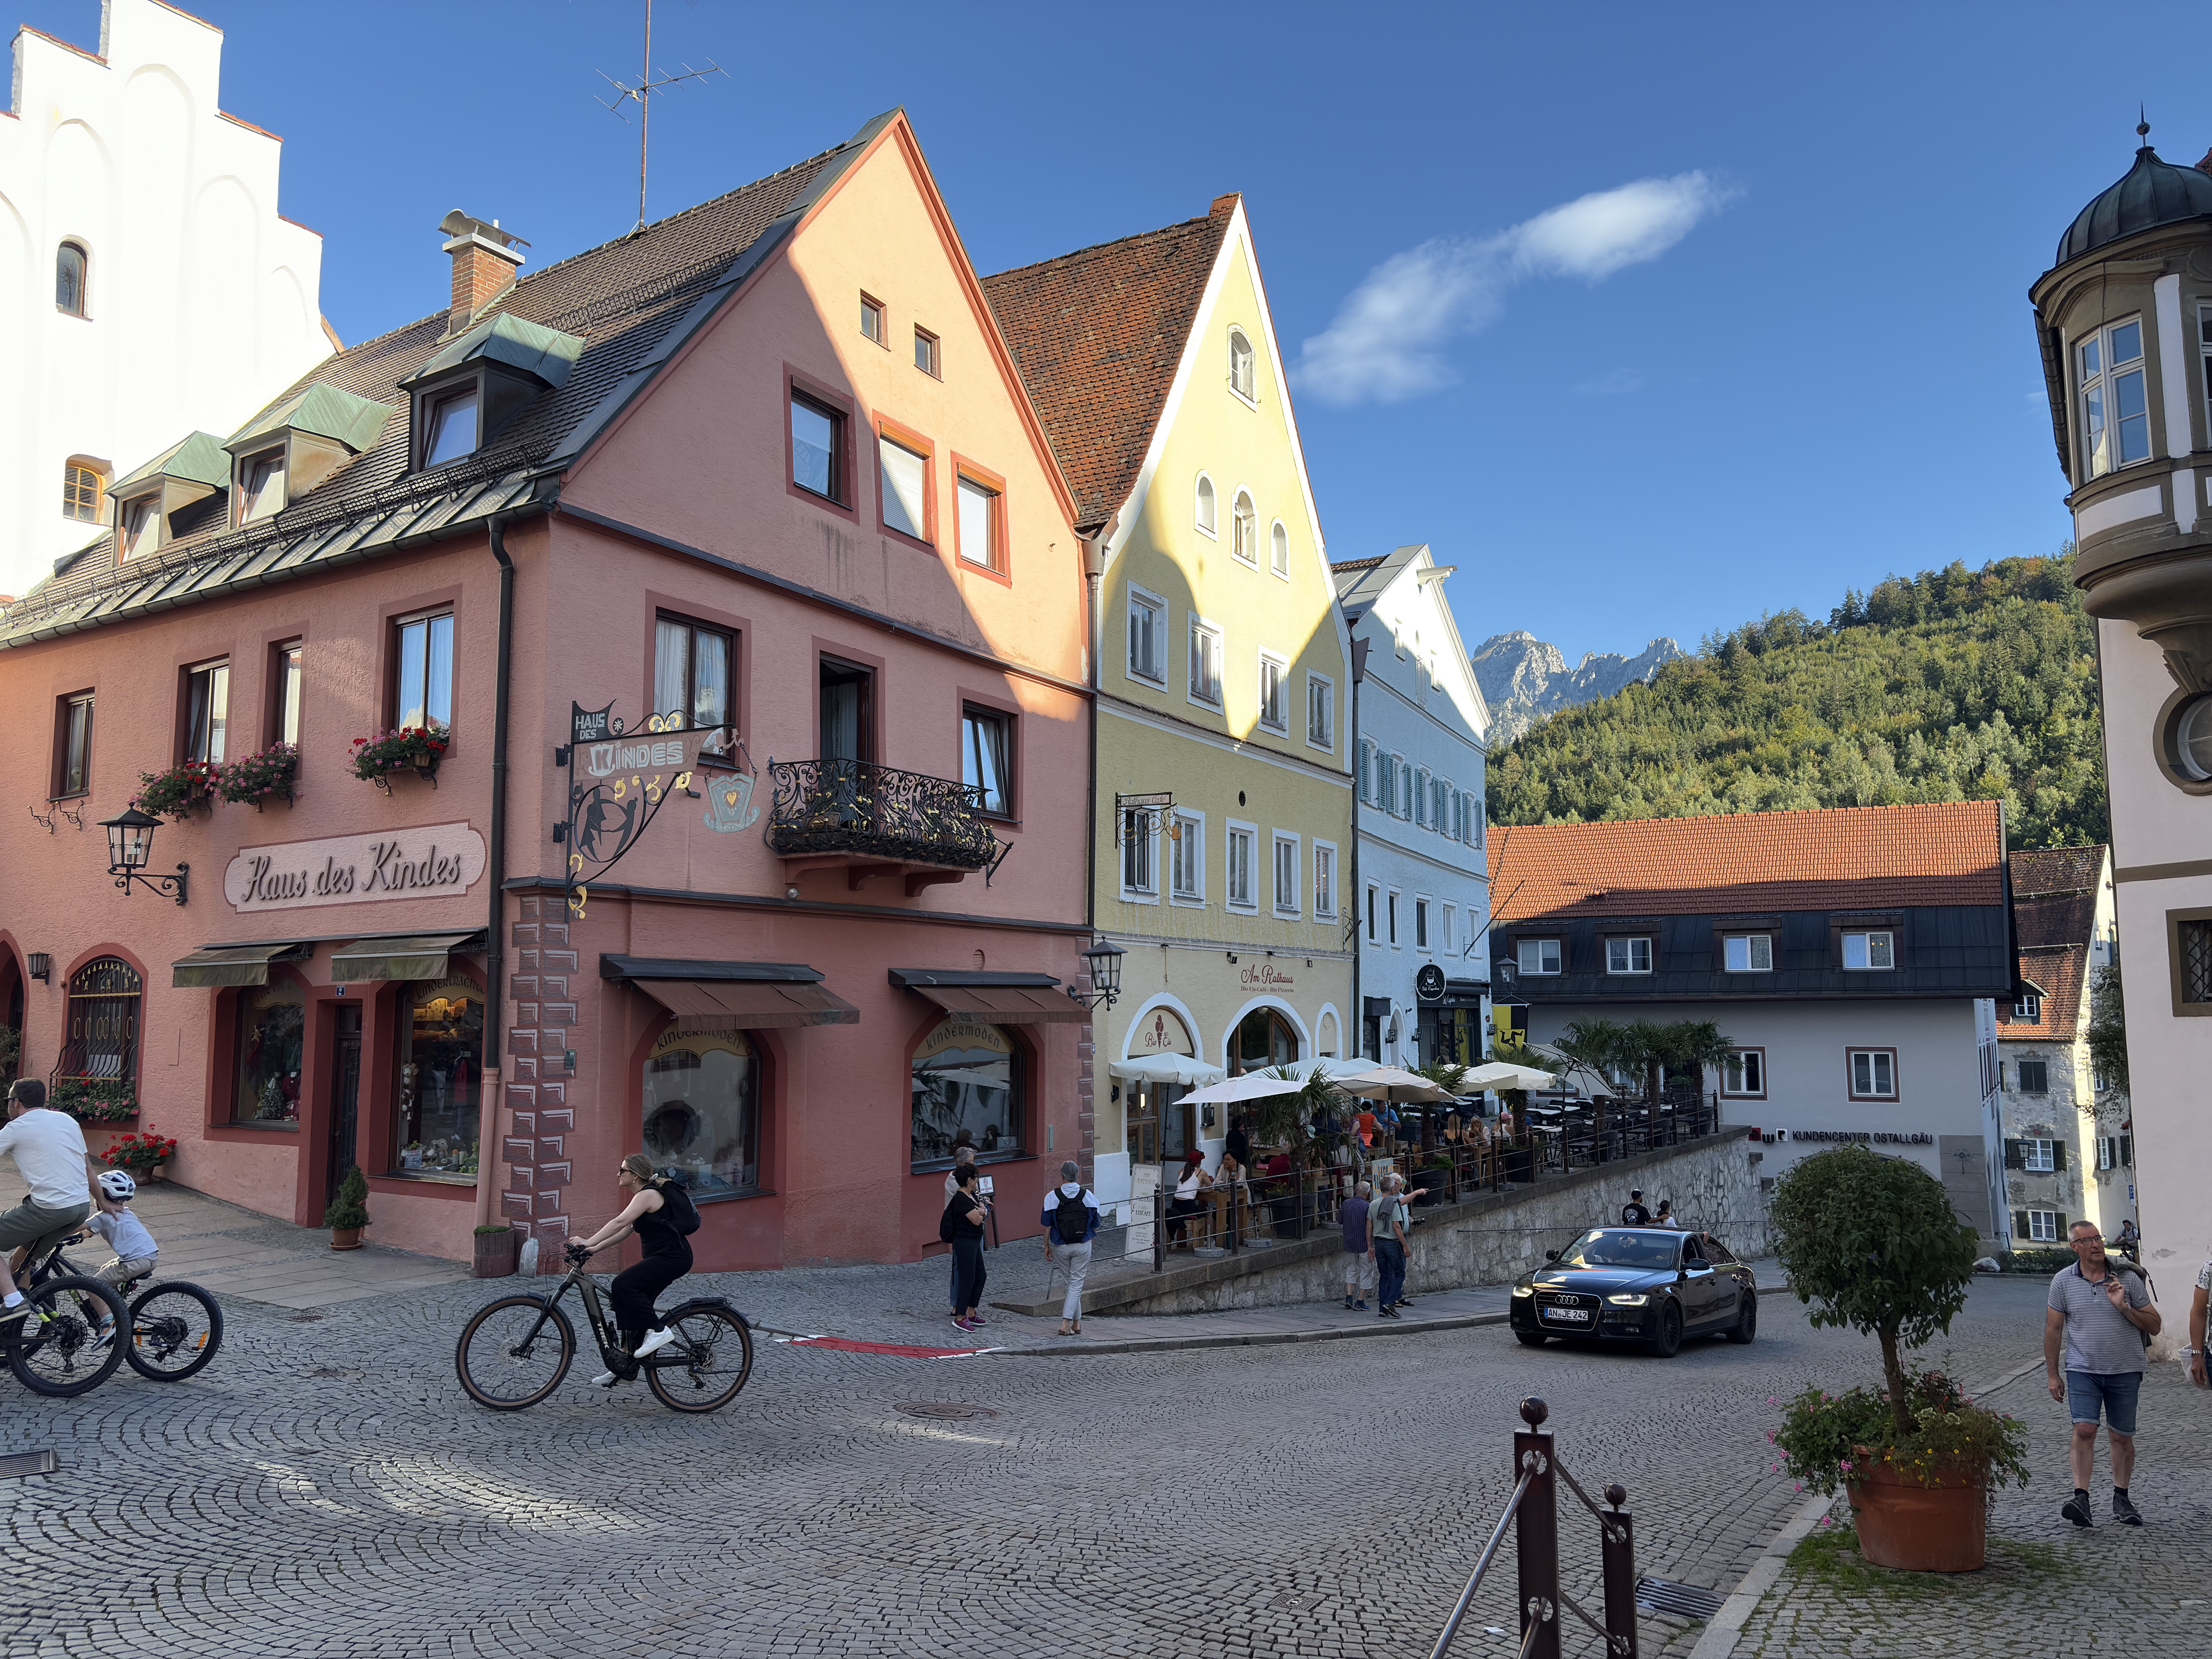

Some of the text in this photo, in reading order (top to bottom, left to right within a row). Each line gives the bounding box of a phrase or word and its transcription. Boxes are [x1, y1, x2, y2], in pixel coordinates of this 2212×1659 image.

[576, 713, 605, 730] HAUS
[580, 728, 596, 740] DES
[1152, 795, 1167, 803] Café
[241, 841, 460, 901] Haus des Kindes
[1241, 964, 1293, 984] Am Rathaus
[1145, 1032, 1171, 1047] Bio Eis
[1793, 1130, 1871, 1142] KUNDENCENTER
[1874, 1131, 1933, 1144] OSTALLGÄU
[1548, 1309, 1587, 1319] AN JE 242
[597, 1321, 609, 1349] TREK
